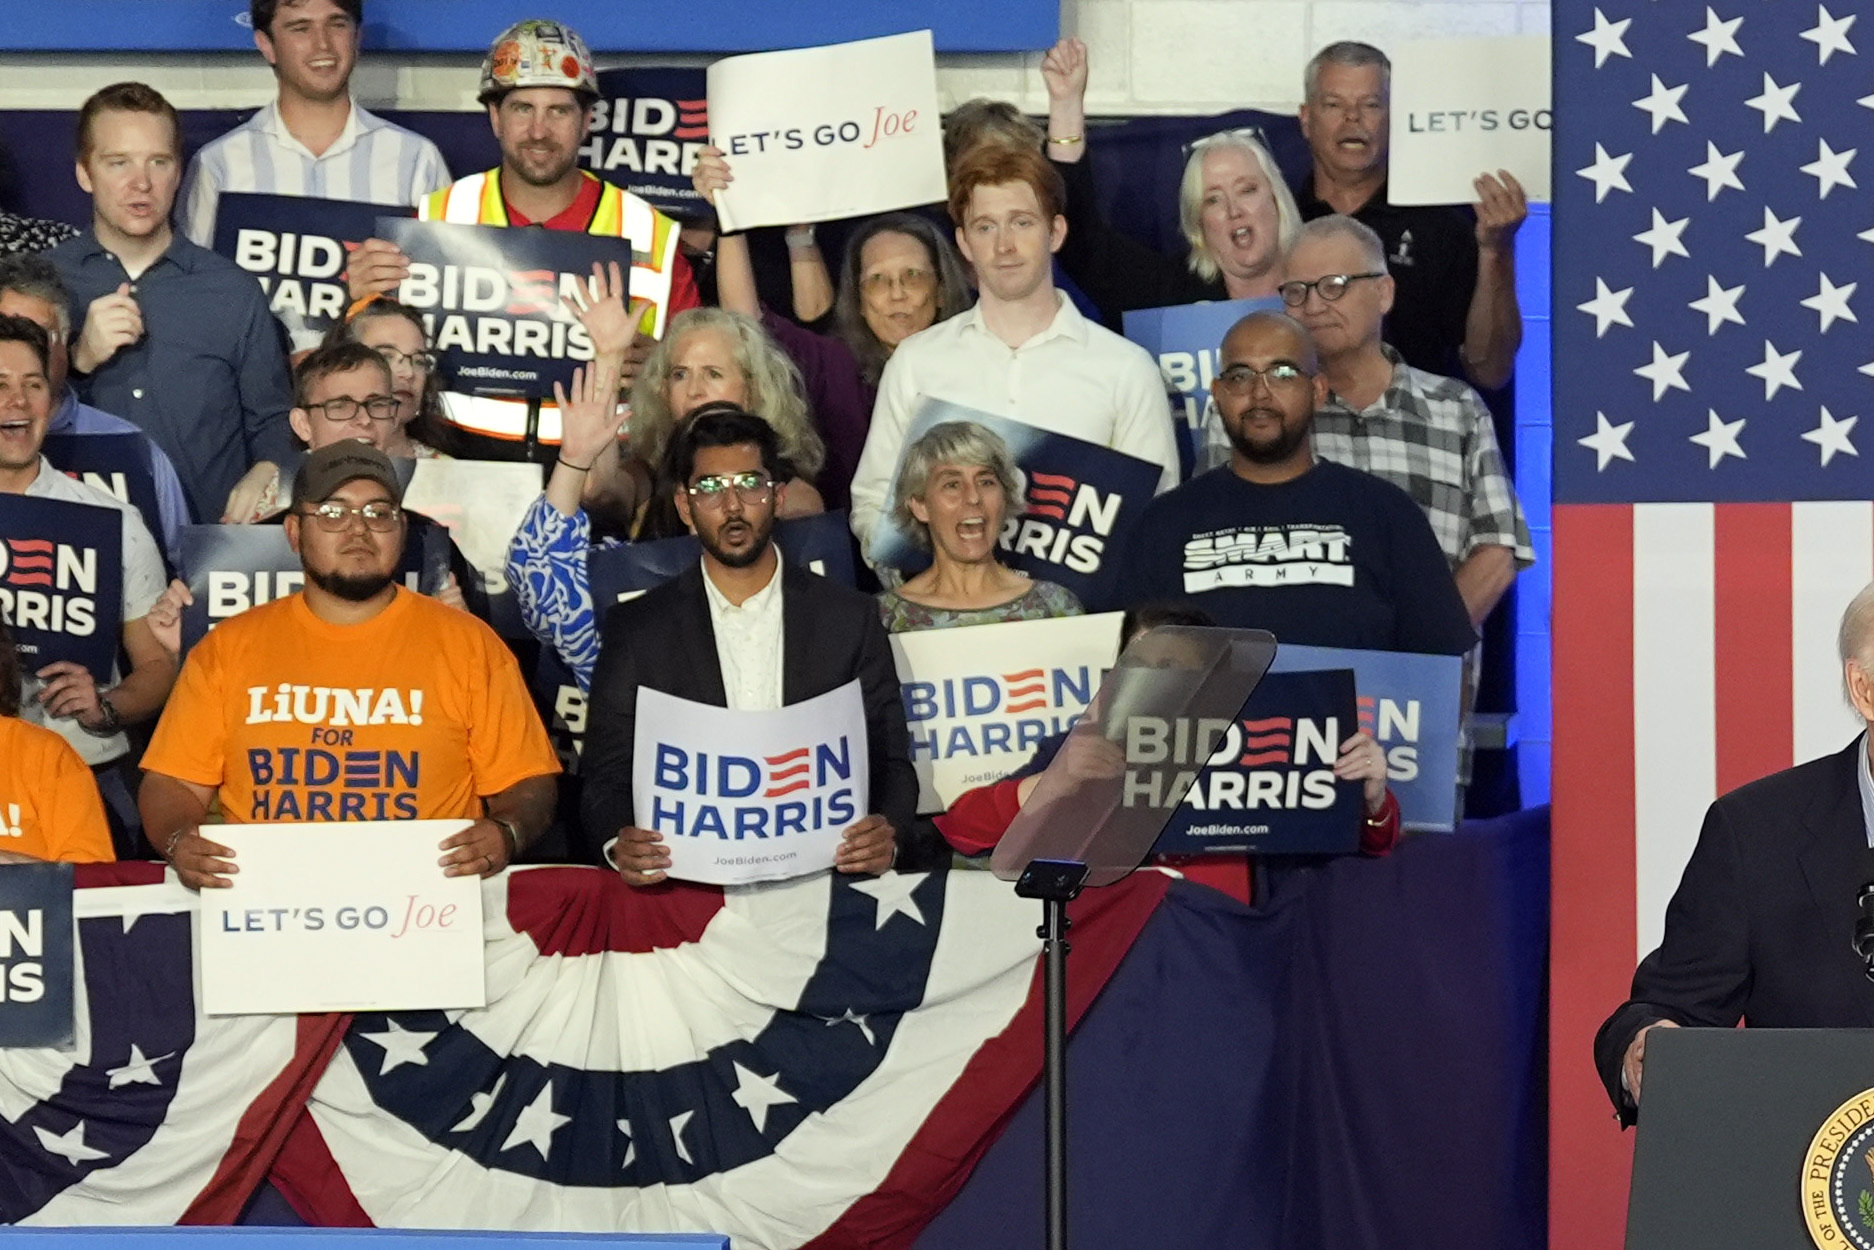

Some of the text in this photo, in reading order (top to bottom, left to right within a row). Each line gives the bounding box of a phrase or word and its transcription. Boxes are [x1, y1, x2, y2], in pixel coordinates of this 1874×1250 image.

[587, 98, 708, 139] BIDE
[815, 121, 860, 146] GO
[863, 105, 918, 149] Joe
[1409, 109, 1552, 133] LET'S GO
[236, 228, 358, 279] BID
[458, 366, 537, 380] JoeBiden.com
[1183, 530, 1351, 570] SMART
[1214, 566, 1318, 583] ARMY
[246, 683, 424, 726] LiUNA!
[900, 666, 1091, 722] BIDEN
[311, 728, 354, 746] FOR
[1126, 716, 1339, 765] BIDEN
[248, 748, 419, 788] BIDEN
[654, 735, 851, 798] BIDEN
[251, 790, 418, 821] HARRIS
[1122, 770, 1336, 810] HARRIS
[651, 788, 855, 840] HARRIS
[1186, 823, 1269, 837] JoeBiden.com
[713, 851, 797, 867] JoeBiden.com
[222, 894, 457, 939] LET'S GO Joe
[1811, 1190, 1826, 1219] THE
[1819, 1223, 1836, 1241] OF
